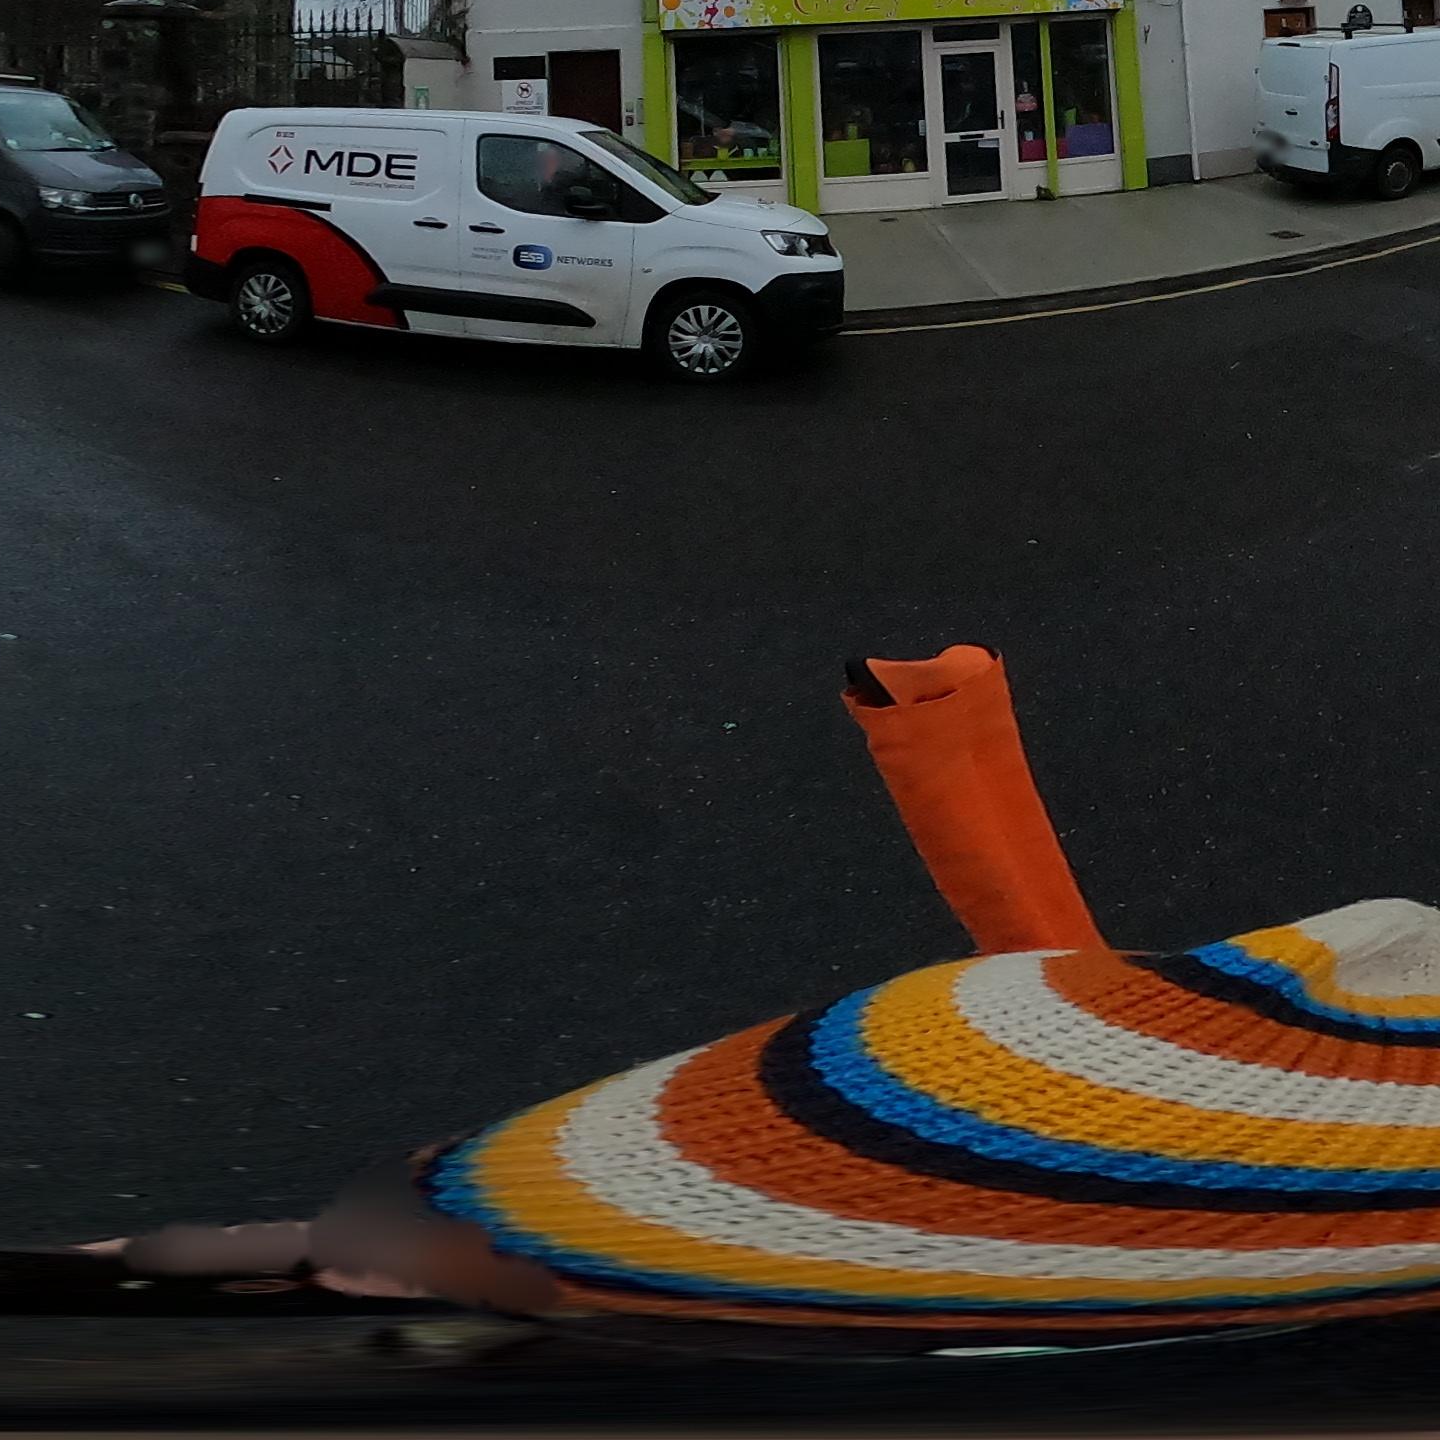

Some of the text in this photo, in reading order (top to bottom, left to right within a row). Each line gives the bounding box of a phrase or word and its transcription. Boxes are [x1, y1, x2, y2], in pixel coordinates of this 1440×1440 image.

[304, 149, 418, 181] MDE
[519, 251, 614, 267] ESB NETWORKS
